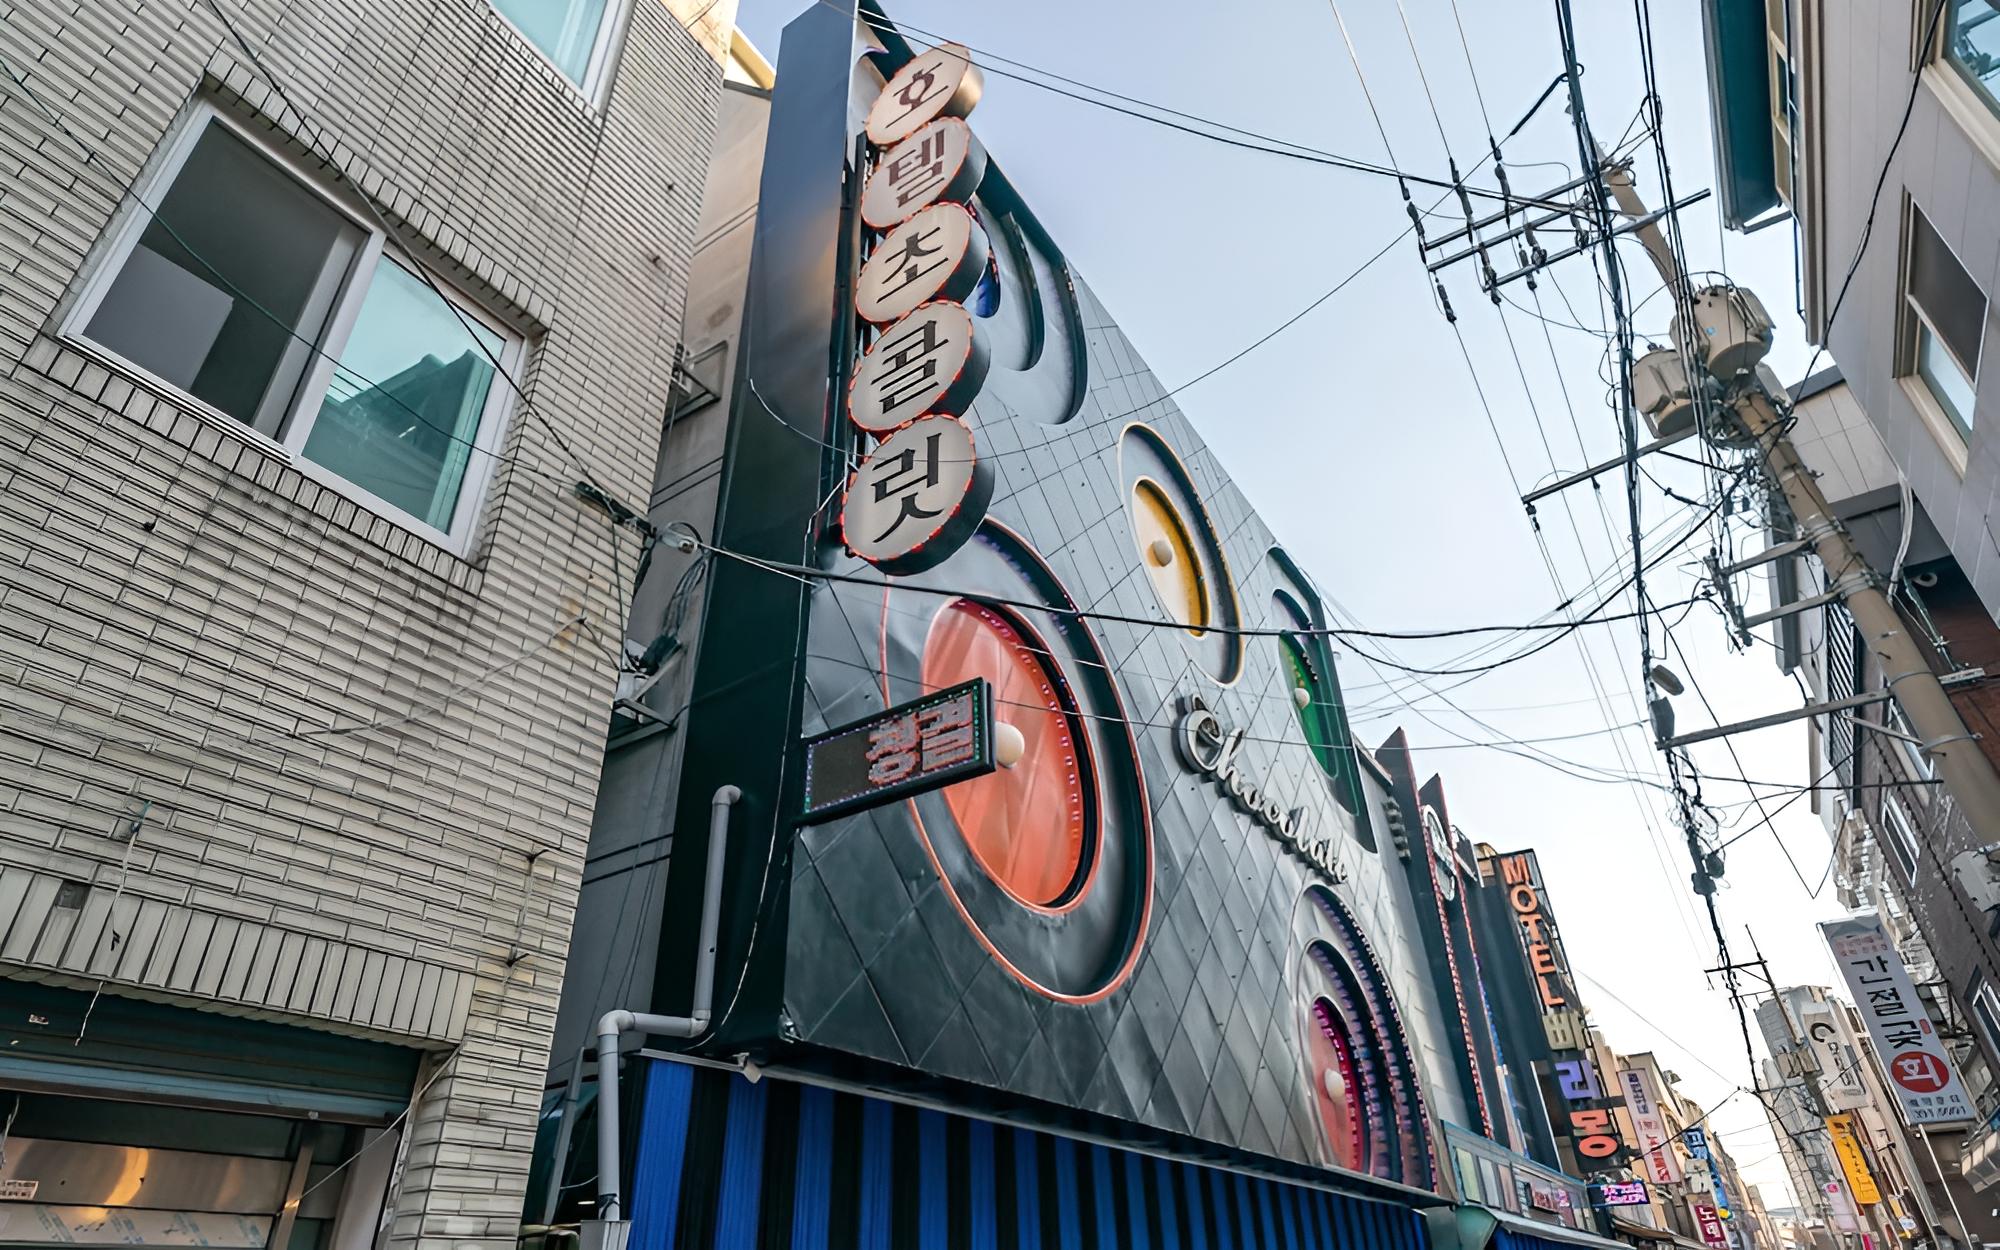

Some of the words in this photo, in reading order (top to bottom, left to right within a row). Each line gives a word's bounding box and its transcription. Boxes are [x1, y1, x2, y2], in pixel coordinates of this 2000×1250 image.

[871, 61, 949, 544] 호텔초콜릿
[1501, 853, 1565, 1006] MOTEL
[1896, 1054, 1943, 1088] 회
